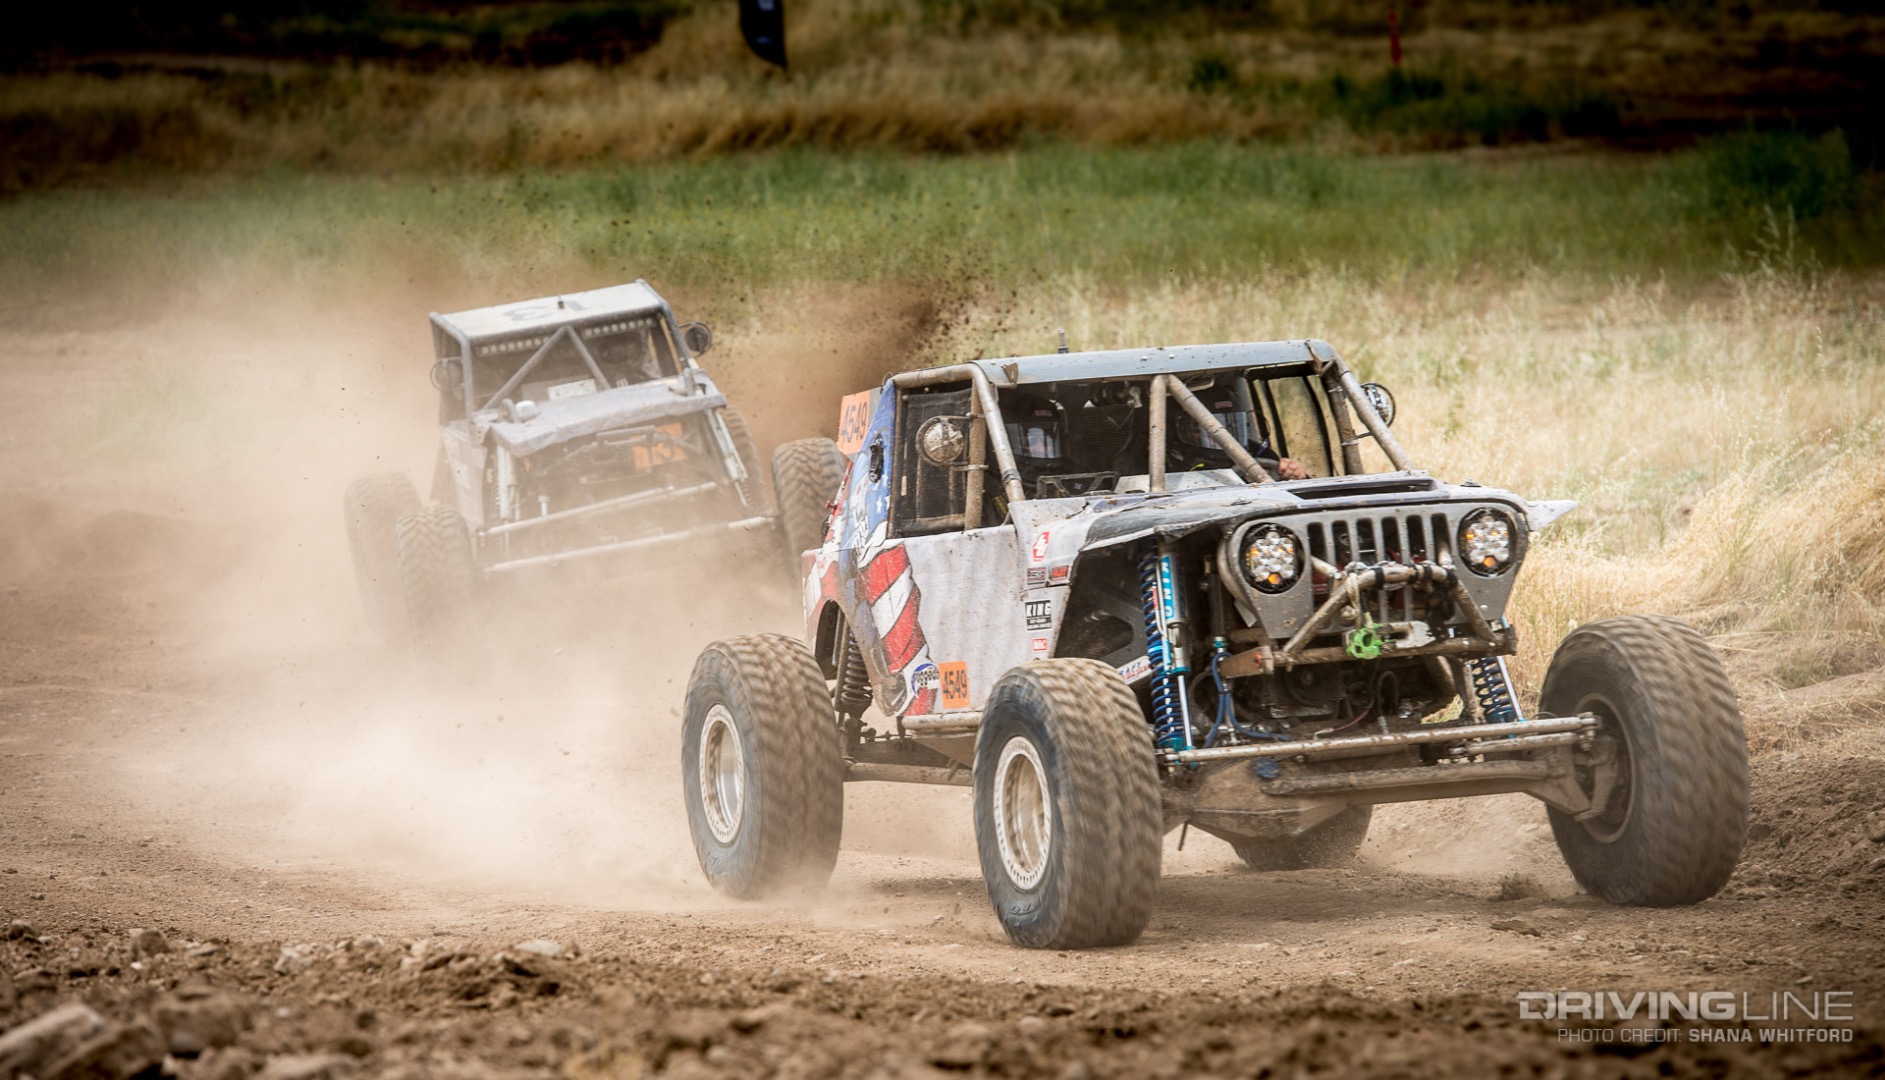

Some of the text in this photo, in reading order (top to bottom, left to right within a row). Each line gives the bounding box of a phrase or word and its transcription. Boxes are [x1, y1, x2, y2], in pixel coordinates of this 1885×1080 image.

[841, 401, 868, 443] 4549
[1026, 600, 1052, 617] KING
[943, 669, 968, 700] 4549
